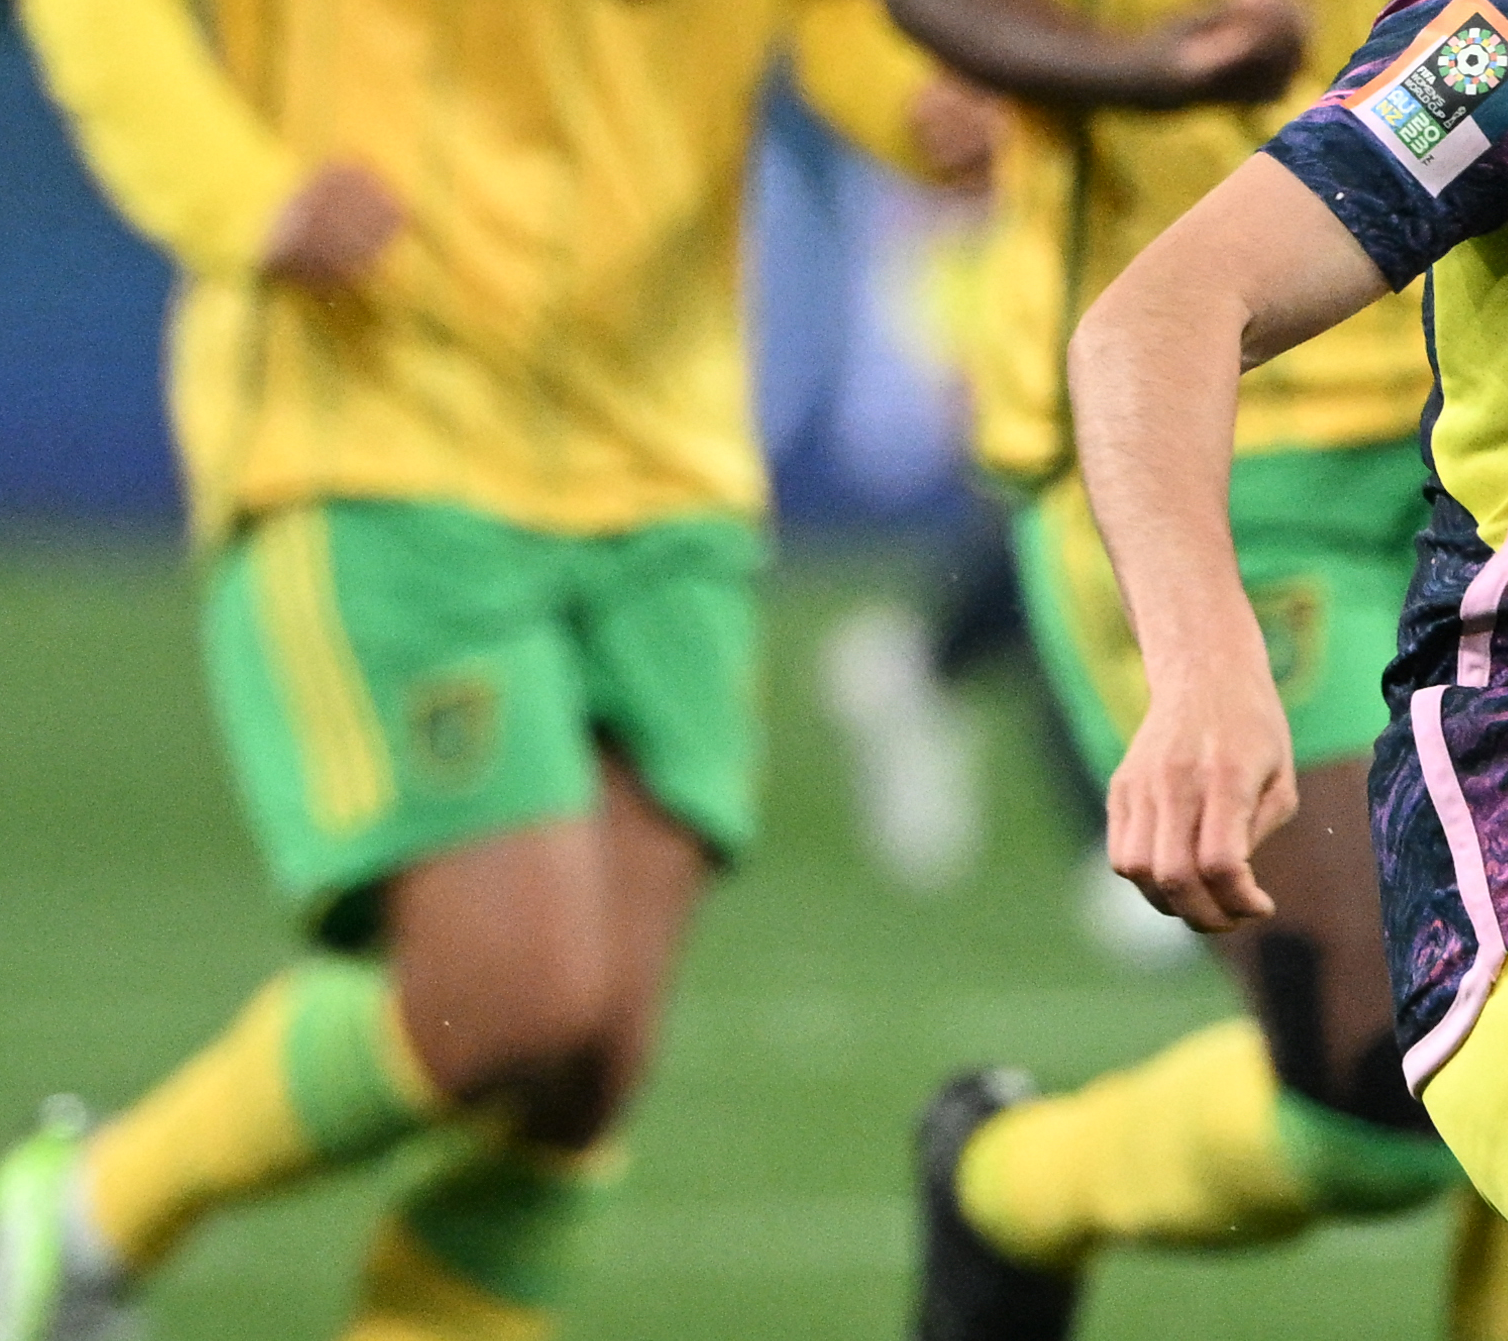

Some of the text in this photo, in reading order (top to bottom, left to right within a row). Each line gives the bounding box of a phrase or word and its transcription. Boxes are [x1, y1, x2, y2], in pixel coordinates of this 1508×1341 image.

[1417, 65, 1437, 85] FIFA
[1388, 90, 1416, 113] AU
[1404, 79, 1446, 119] WORLD CUP
[1410, 73, 1445, 108] WOMEN'S
[1376, 99, 1403, 126] NZ
